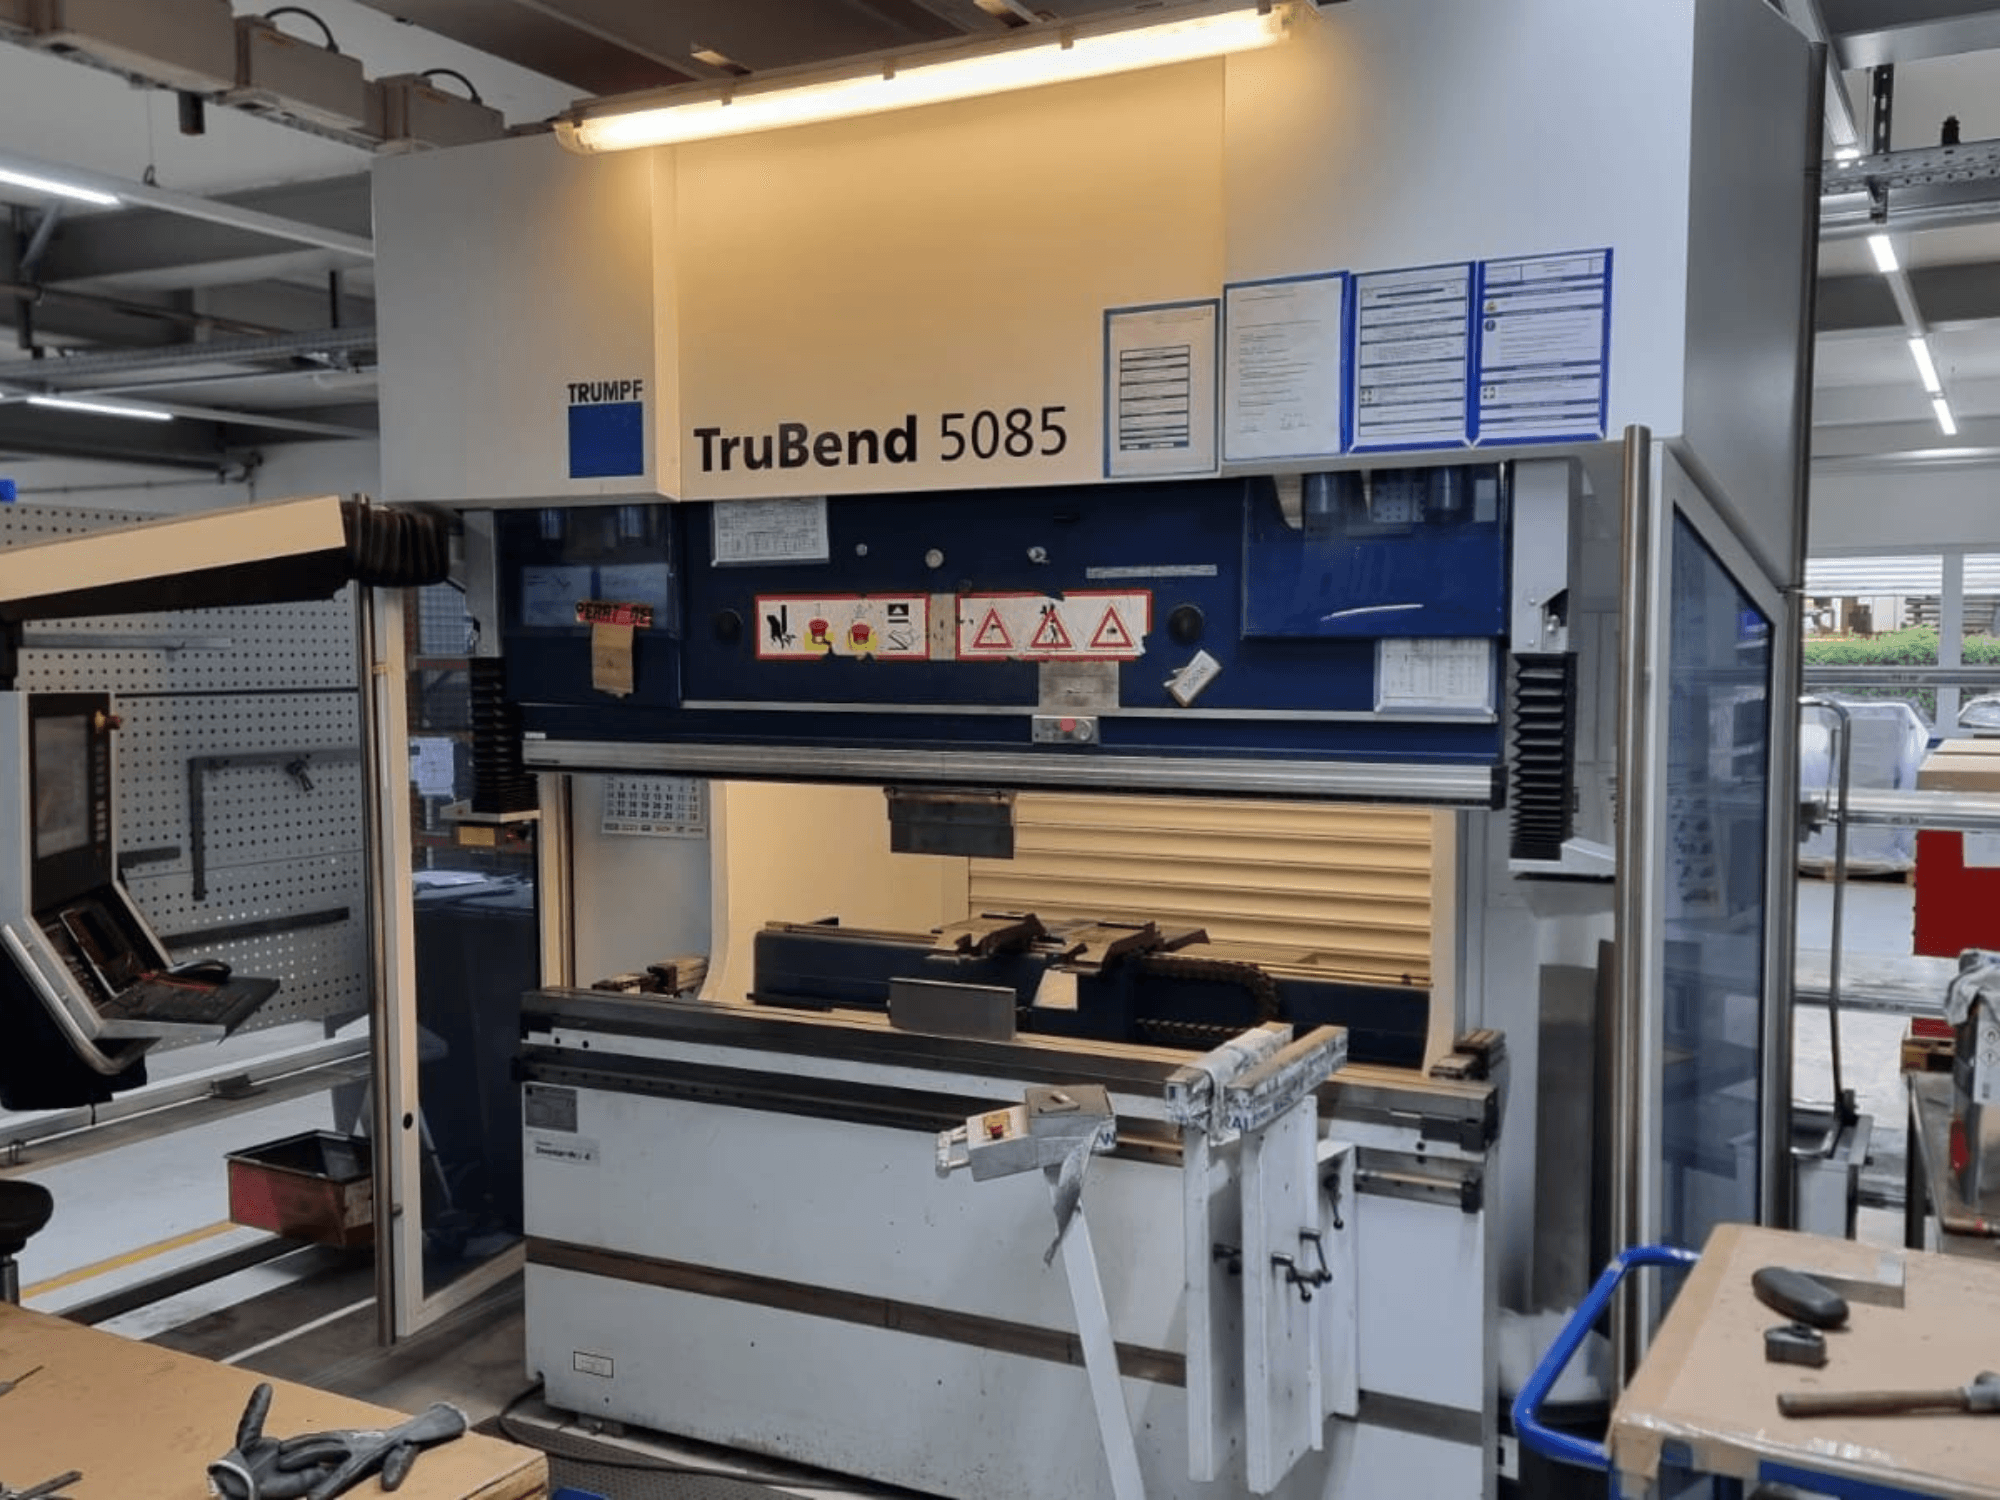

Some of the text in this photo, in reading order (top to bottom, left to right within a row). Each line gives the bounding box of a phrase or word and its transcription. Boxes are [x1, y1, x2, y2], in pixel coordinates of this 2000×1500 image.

[567, 379, 643, 403] TRUMPF
[693, 405, 1067, 473] TruBend 5085
